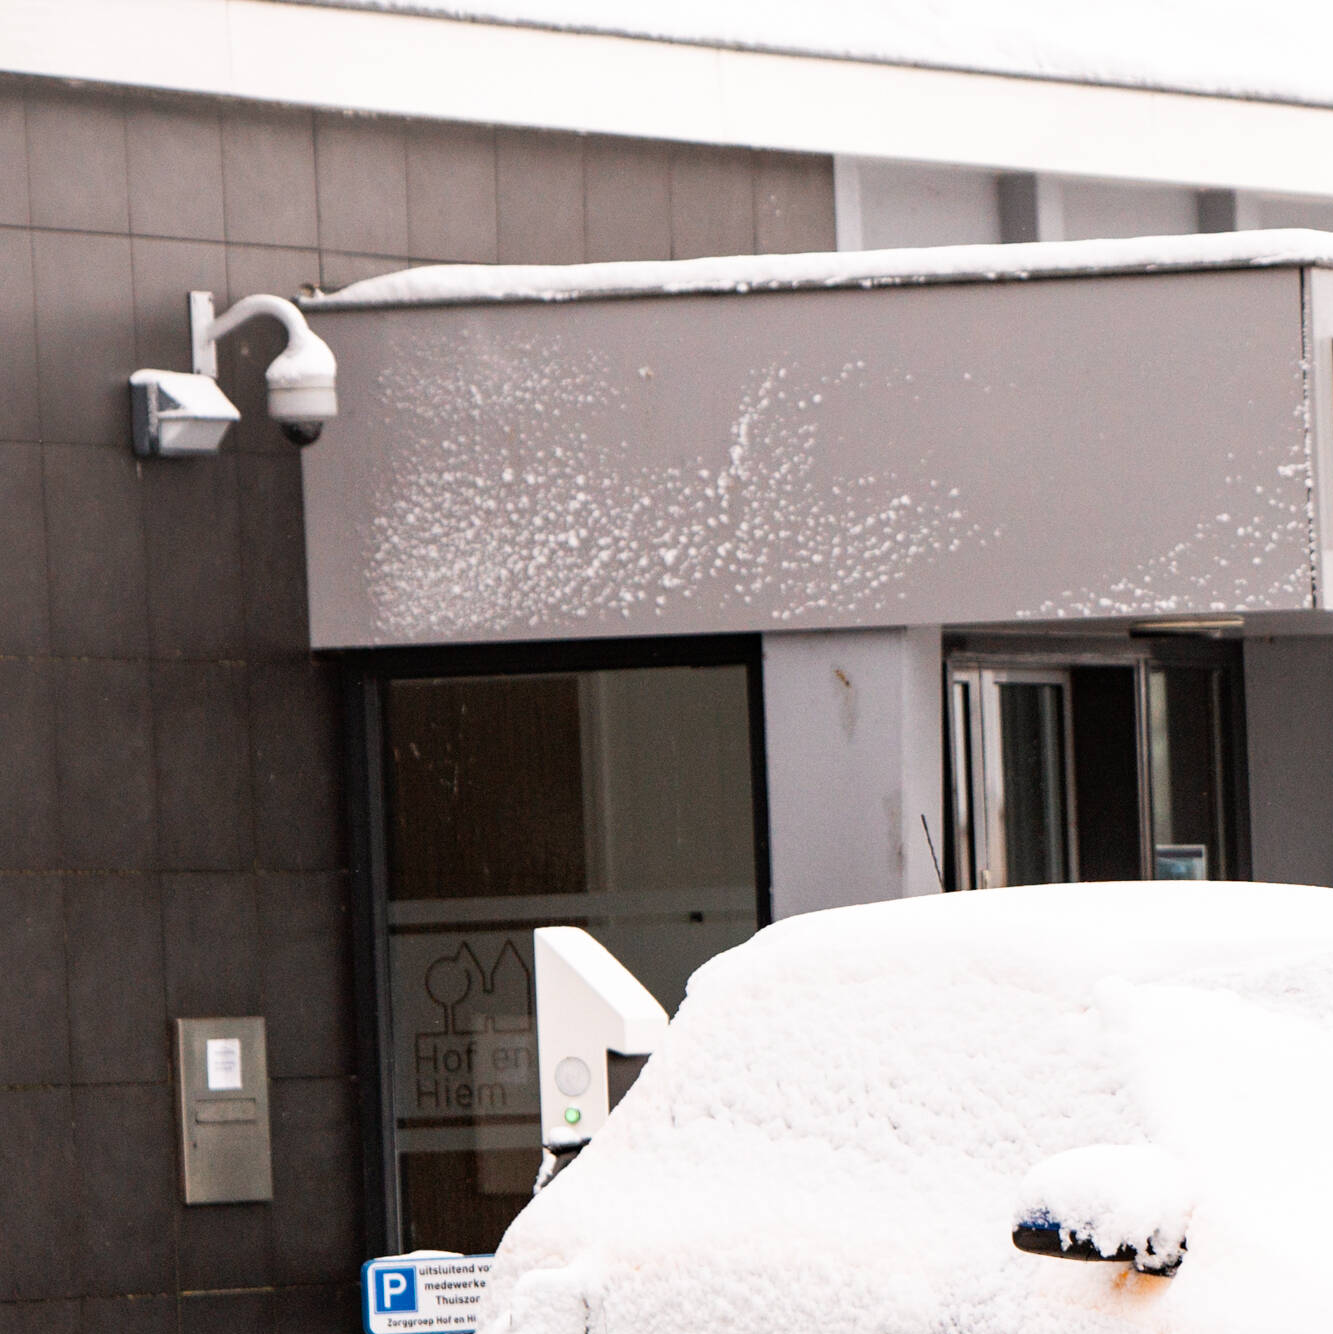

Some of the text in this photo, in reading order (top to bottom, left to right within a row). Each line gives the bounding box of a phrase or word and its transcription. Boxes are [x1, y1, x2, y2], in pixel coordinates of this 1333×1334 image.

[415, 1041, 534, 1075] Hof en
[416, 1078, 508, 1109] Hiem
[418, 1263, 492, 1276] uitsluitend vo
[382, 1272, 408, 1309] P
[424, 1278, 487, 1291] medewerke
[435, 1294, 481, 1306] Thuiszor
[386, 1317, 434, 1329] Zorggroep
[435, 1315, 452, 1325] Hof
[454, 1316, 465, 1324] en
